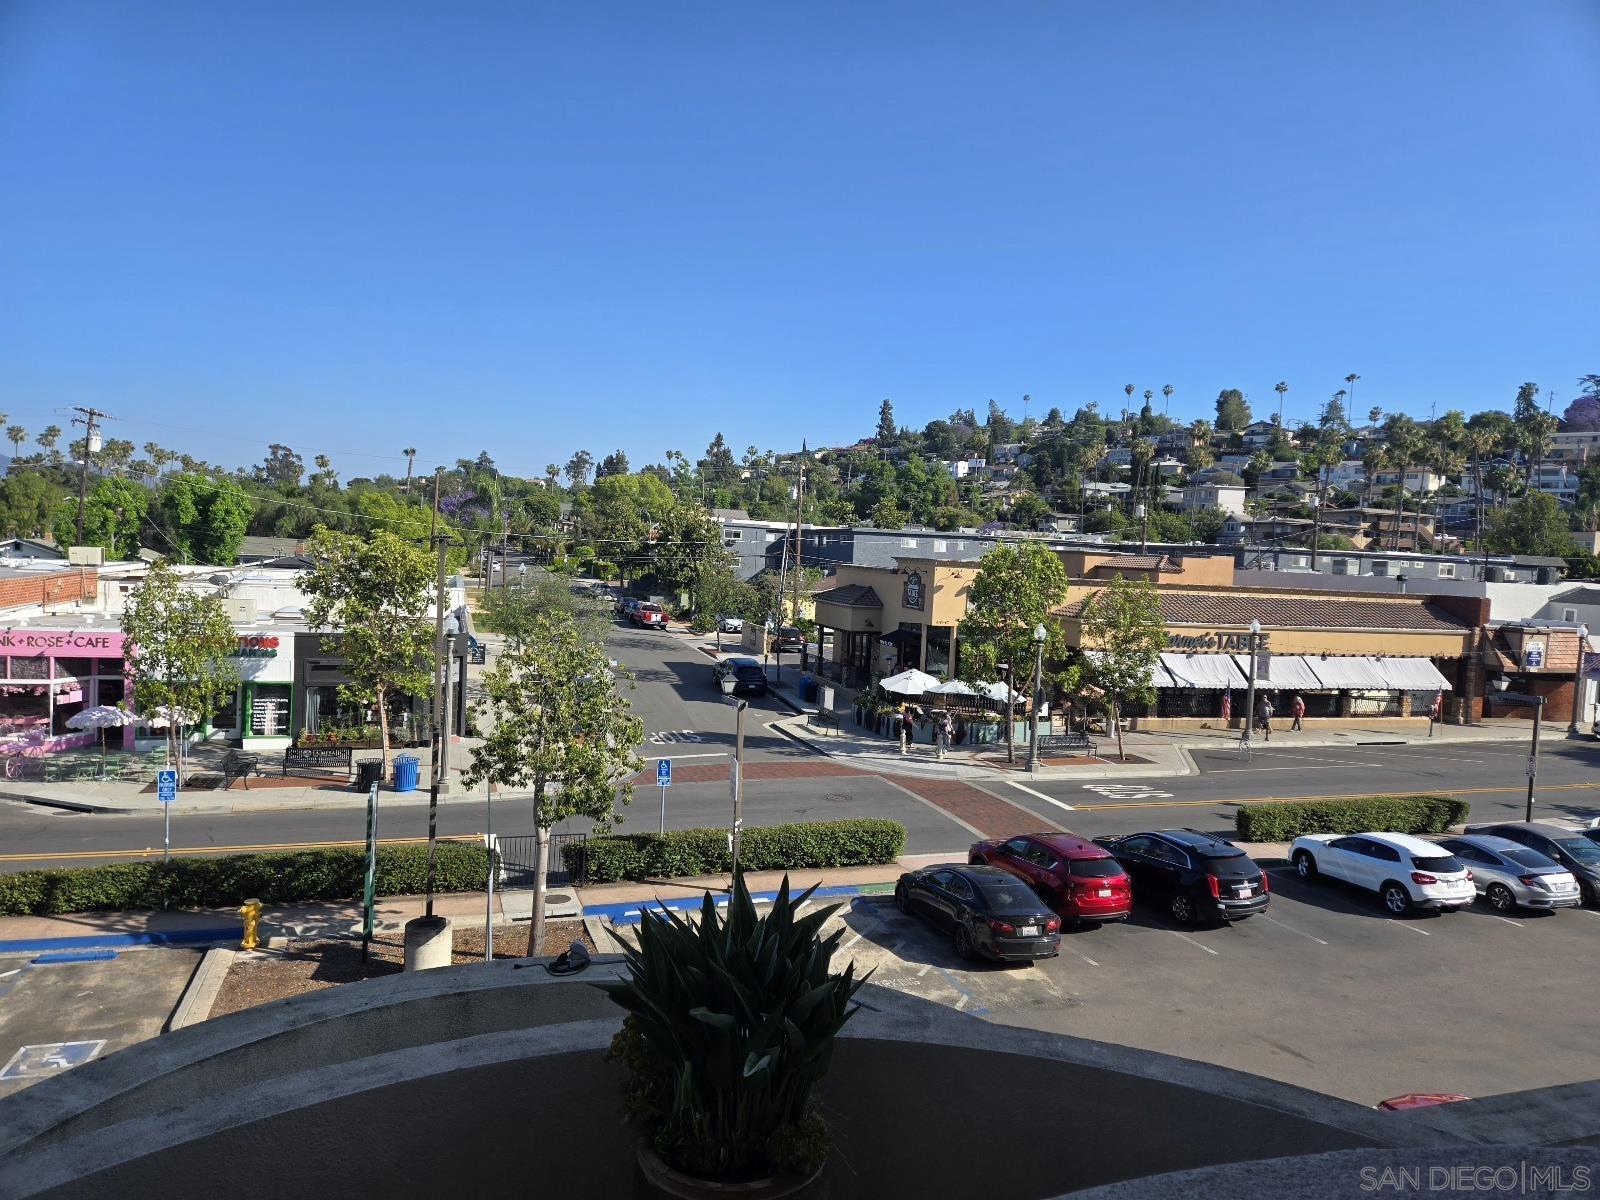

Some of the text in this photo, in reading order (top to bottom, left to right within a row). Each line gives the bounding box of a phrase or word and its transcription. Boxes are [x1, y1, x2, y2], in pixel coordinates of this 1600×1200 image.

[26, 636, 64, 647] ROSE
[74, 637, 110, 648] CAFE
[650, 729, 702, 744] STOP
[868, 977, 921, 989] ARKING
